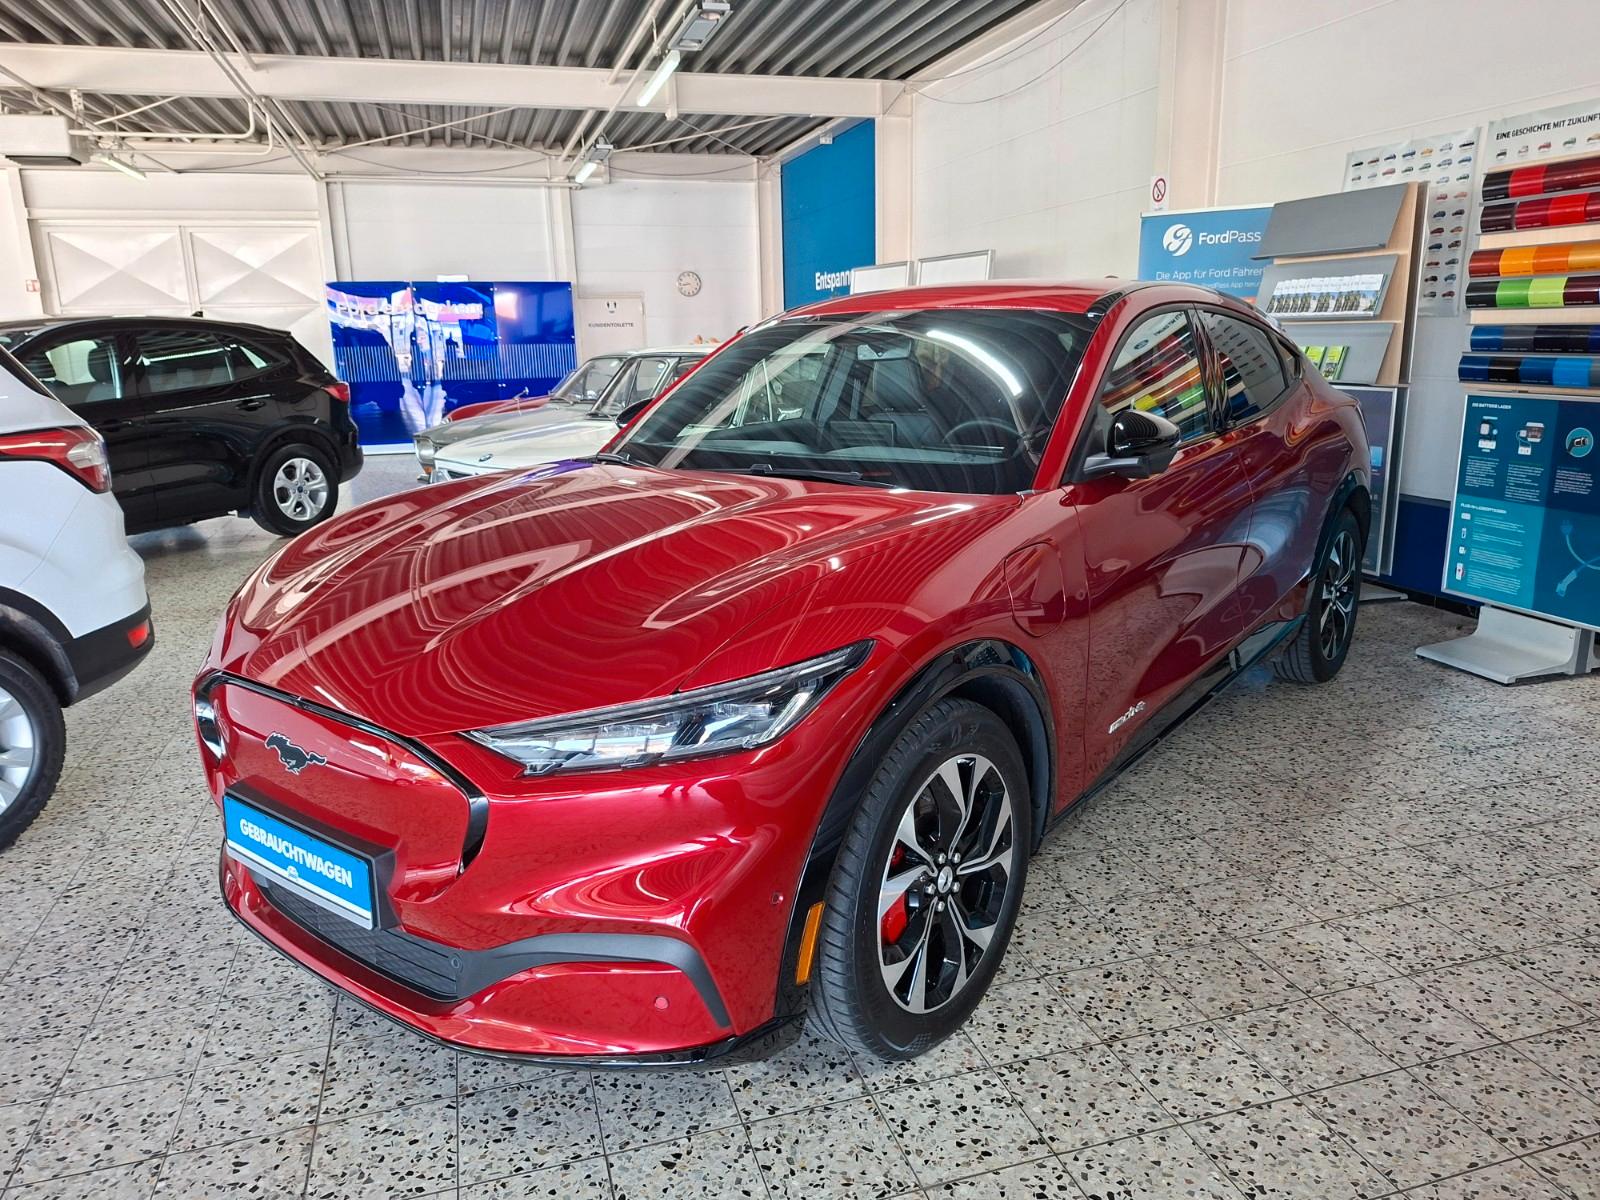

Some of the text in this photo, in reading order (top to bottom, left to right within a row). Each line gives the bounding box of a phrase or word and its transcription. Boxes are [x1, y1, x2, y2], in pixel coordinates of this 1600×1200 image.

[1496, 131, 1511, 140] EINE
[1511, 123, 1551, 137] GESCHICHTE
[1552, 119, 1566, 129] MIT
[1198, 230, 1261, 245] FordPass
[815, 270, 851, 292] Entspann
[1156, 271, 1170, 280] Die
[1172, 270, 1191, 281] App
[1208, 268, 1230, 278] Ford
[239, 818, 353, 889] GEBRAUCHTWAGEN
